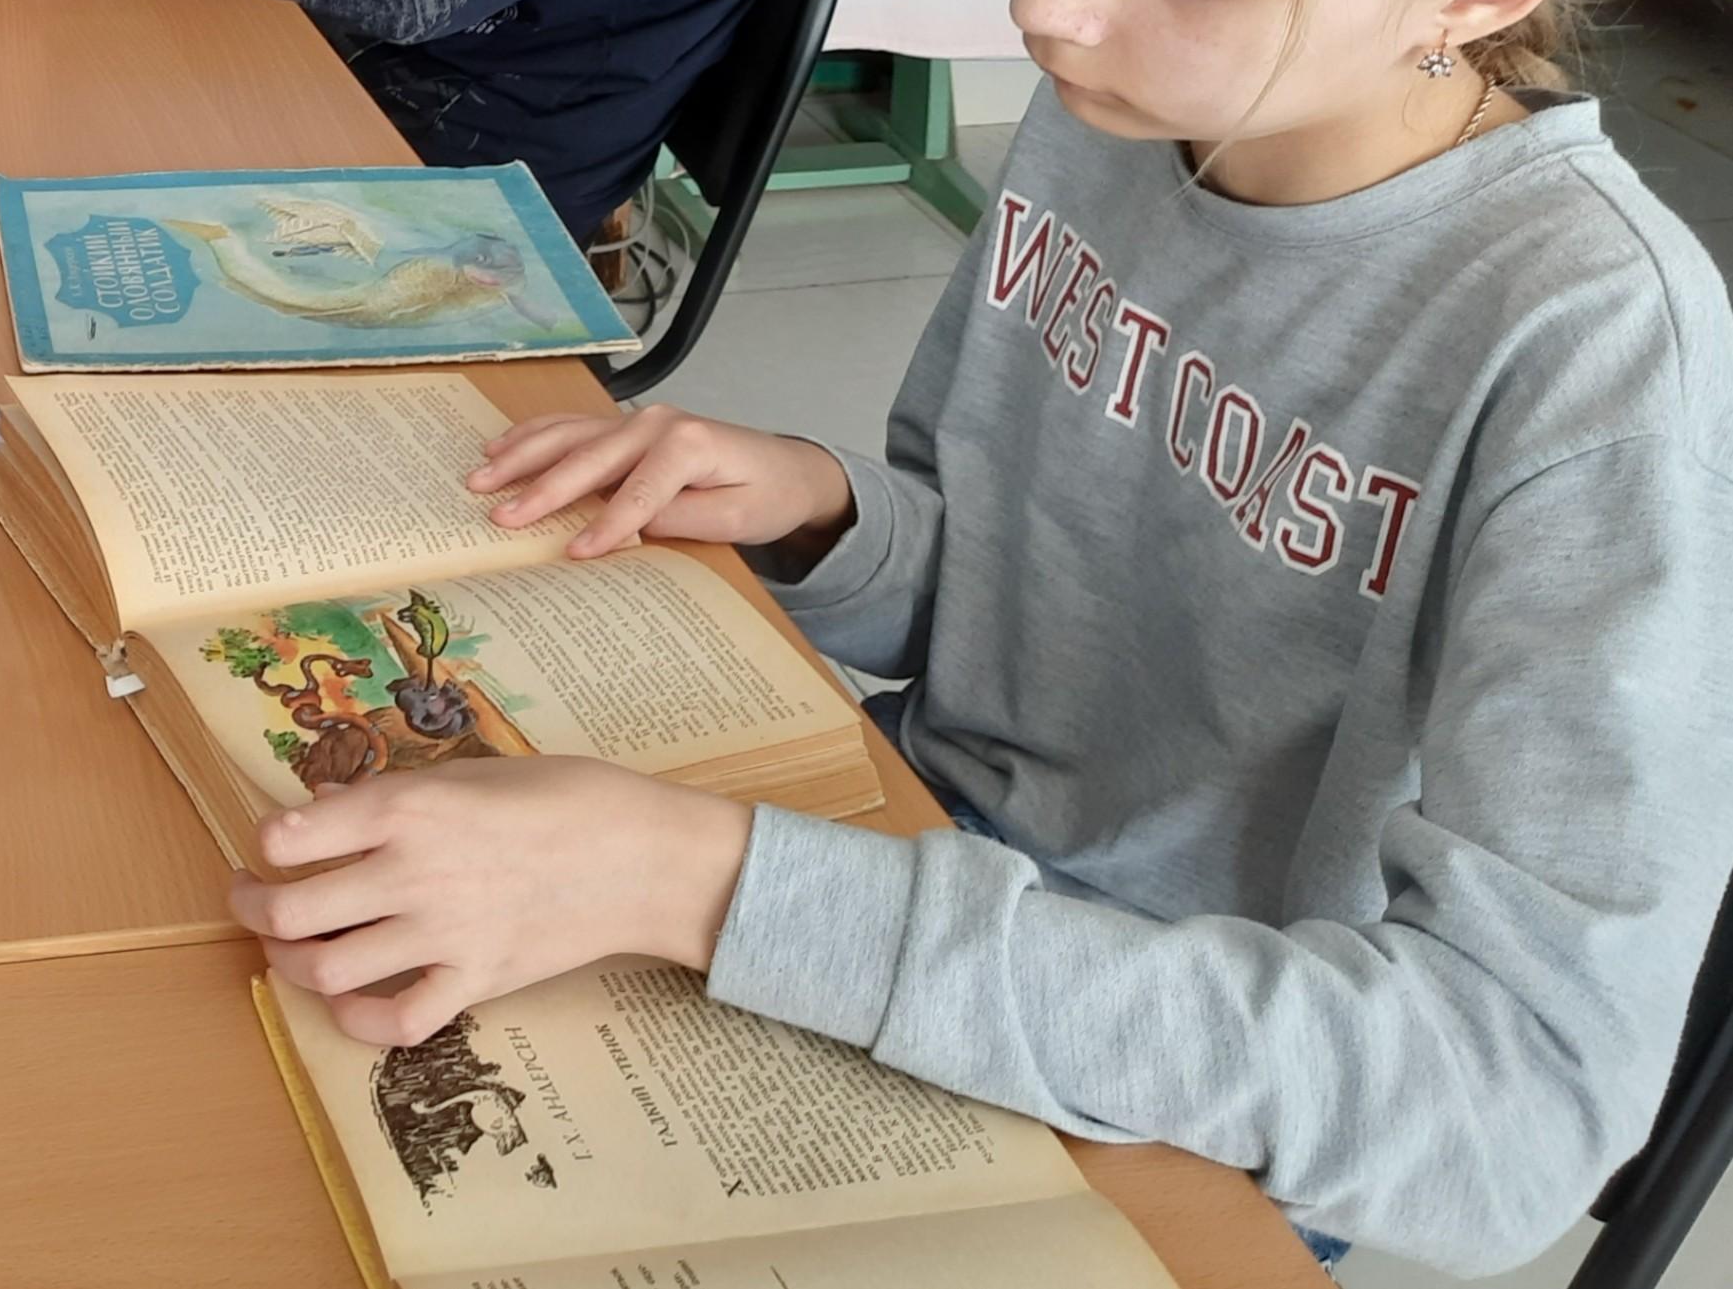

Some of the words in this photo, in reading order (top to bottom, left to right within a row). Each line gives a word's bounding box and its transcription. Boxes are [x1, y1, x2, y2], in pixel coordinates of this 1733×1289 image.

[76, 232, 124, 309] СТОЙКИЙ
[97, 220, 156, 320] ОЛОВЯННЫЙ
[134, 227, 181, 314] СОЛДАТИК
[987, 188, 1172, 429] WEST
[1165, 349, 1422, 602] COAST
[503, 1024, 571, 1123] АНДЕРСЕН
[594, 1022, 639, 1081] УТЕНОК
[629, 1084, 678, 1148] ГАДКИЙ
